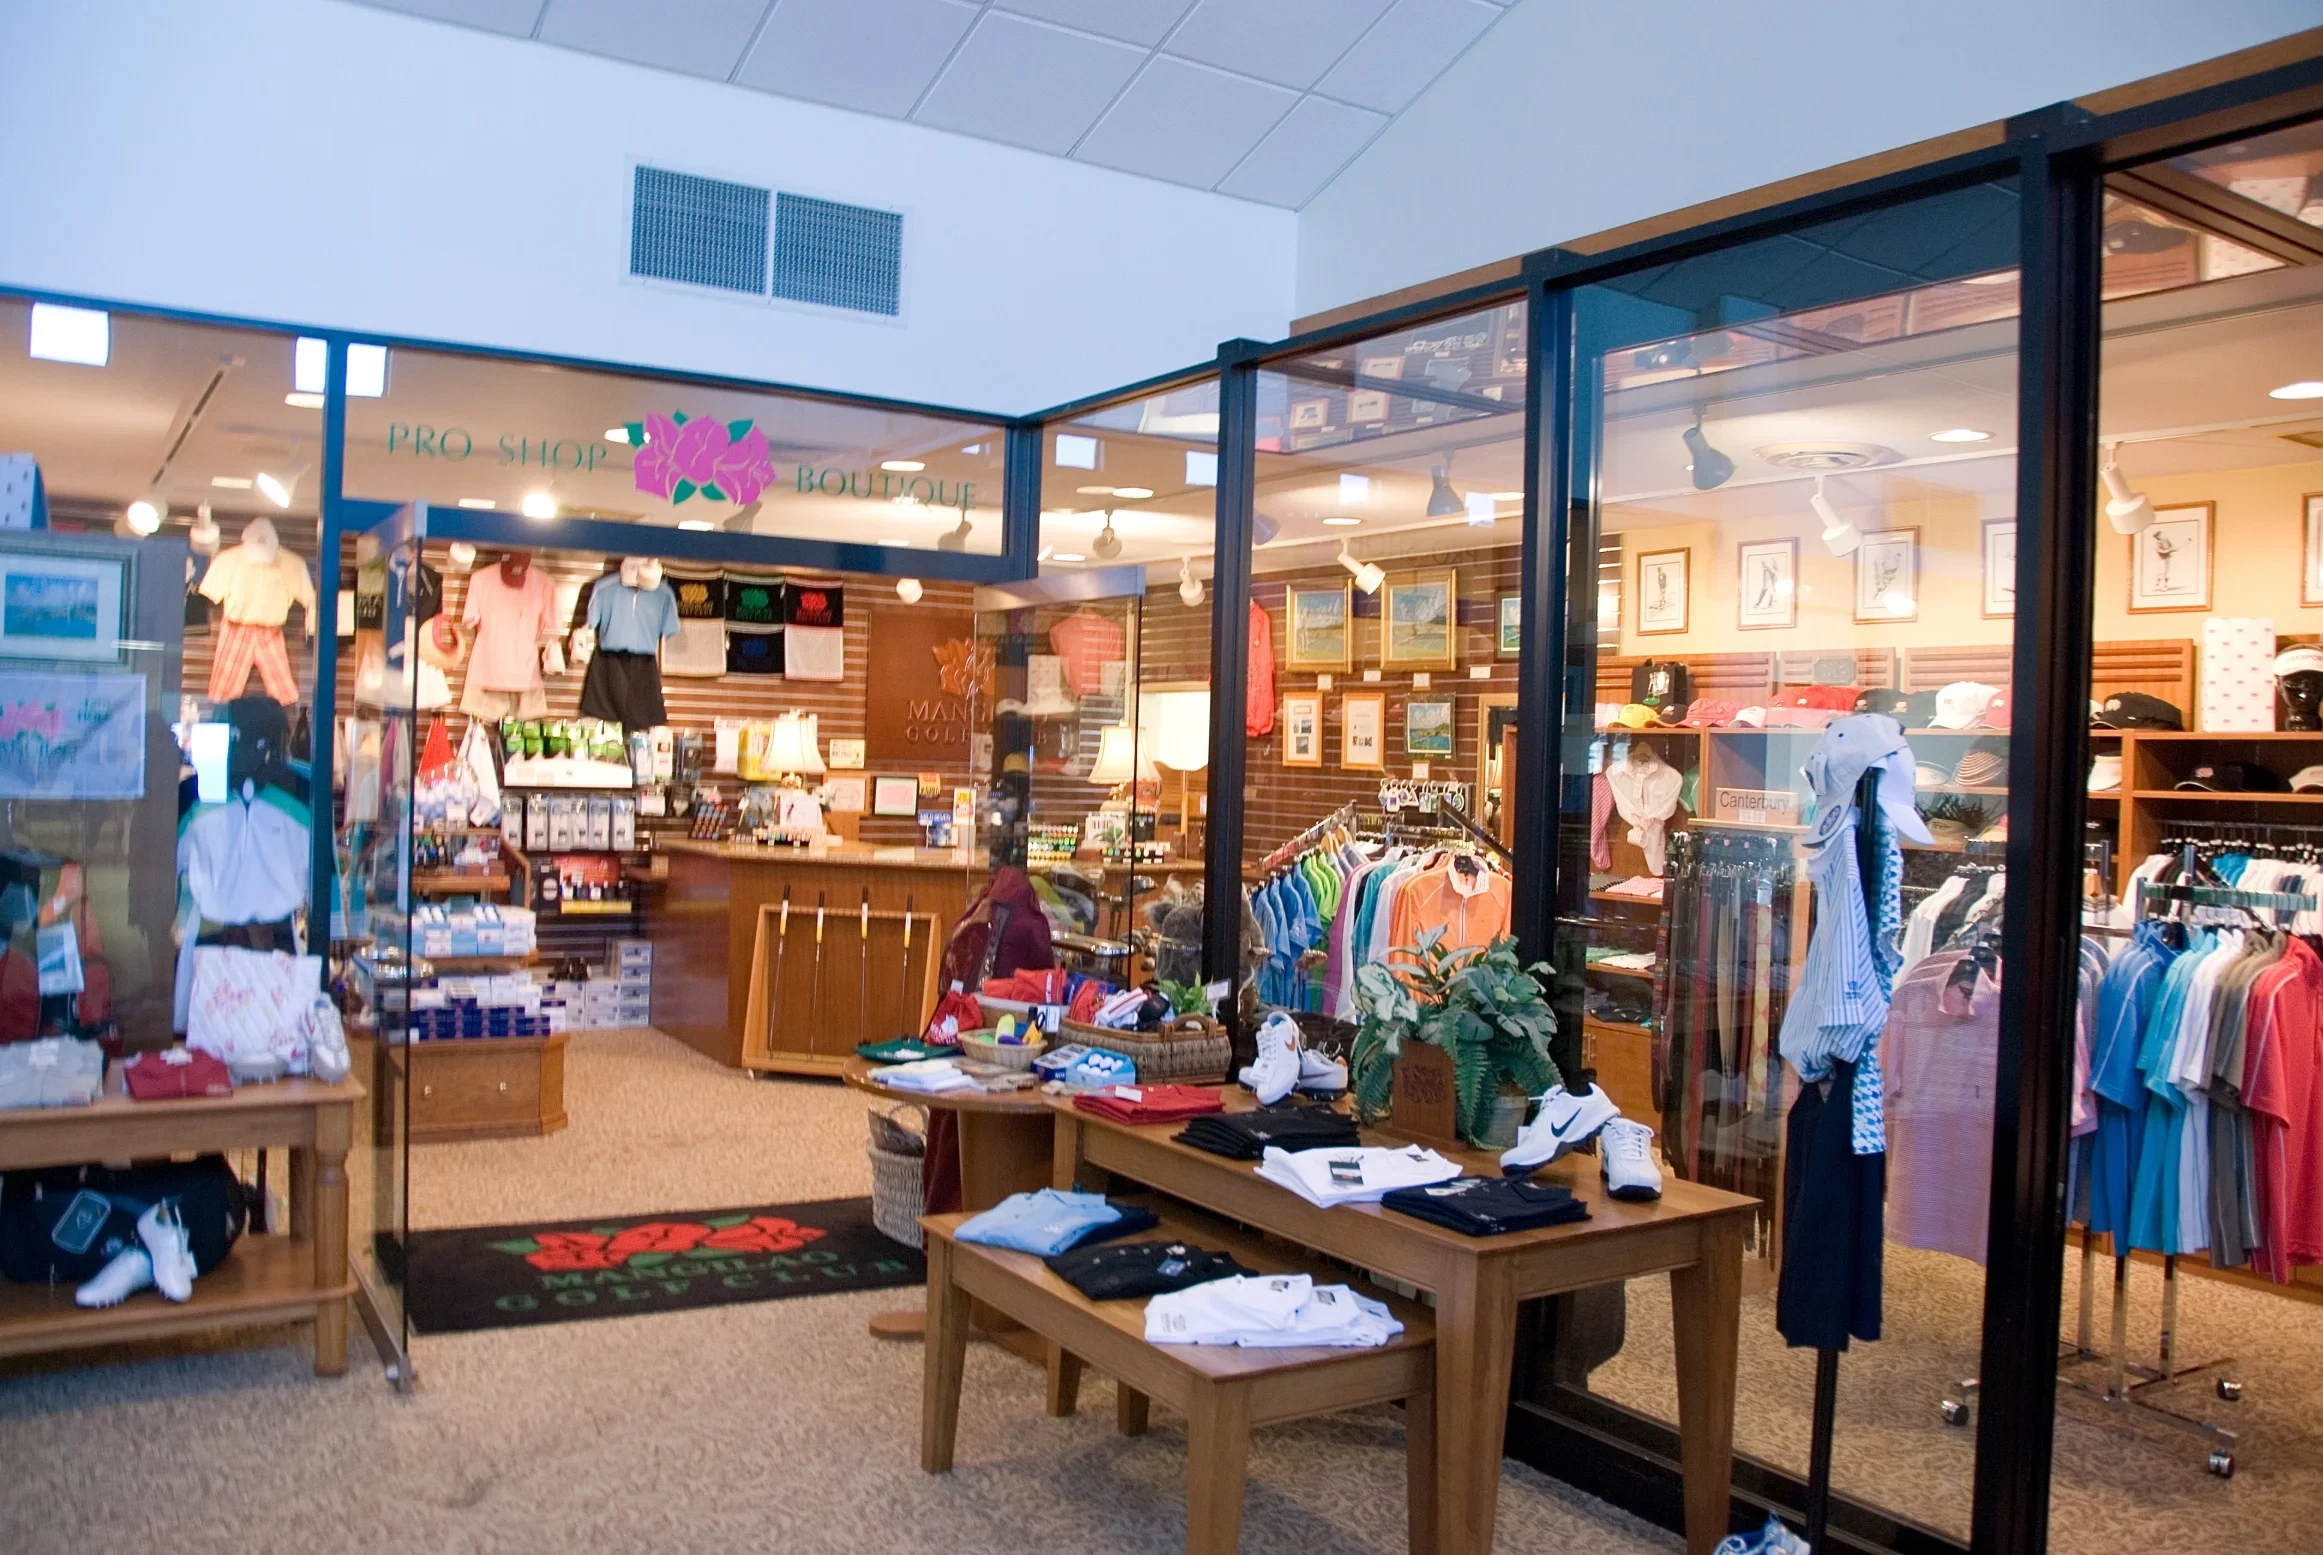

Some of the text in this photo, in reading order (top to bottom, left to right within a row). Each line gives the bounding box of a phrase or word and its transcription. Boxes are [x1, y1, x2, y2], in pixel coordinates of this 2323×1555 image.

[389, 422, 977, 512] PRO SHOP BOUTIQUE
[1719, 791, 1790, 815] Canterbury
[494, 1259, 909, 1312] GOLF CLUB
[541, 1250, 839, 1289] MANGILAO
